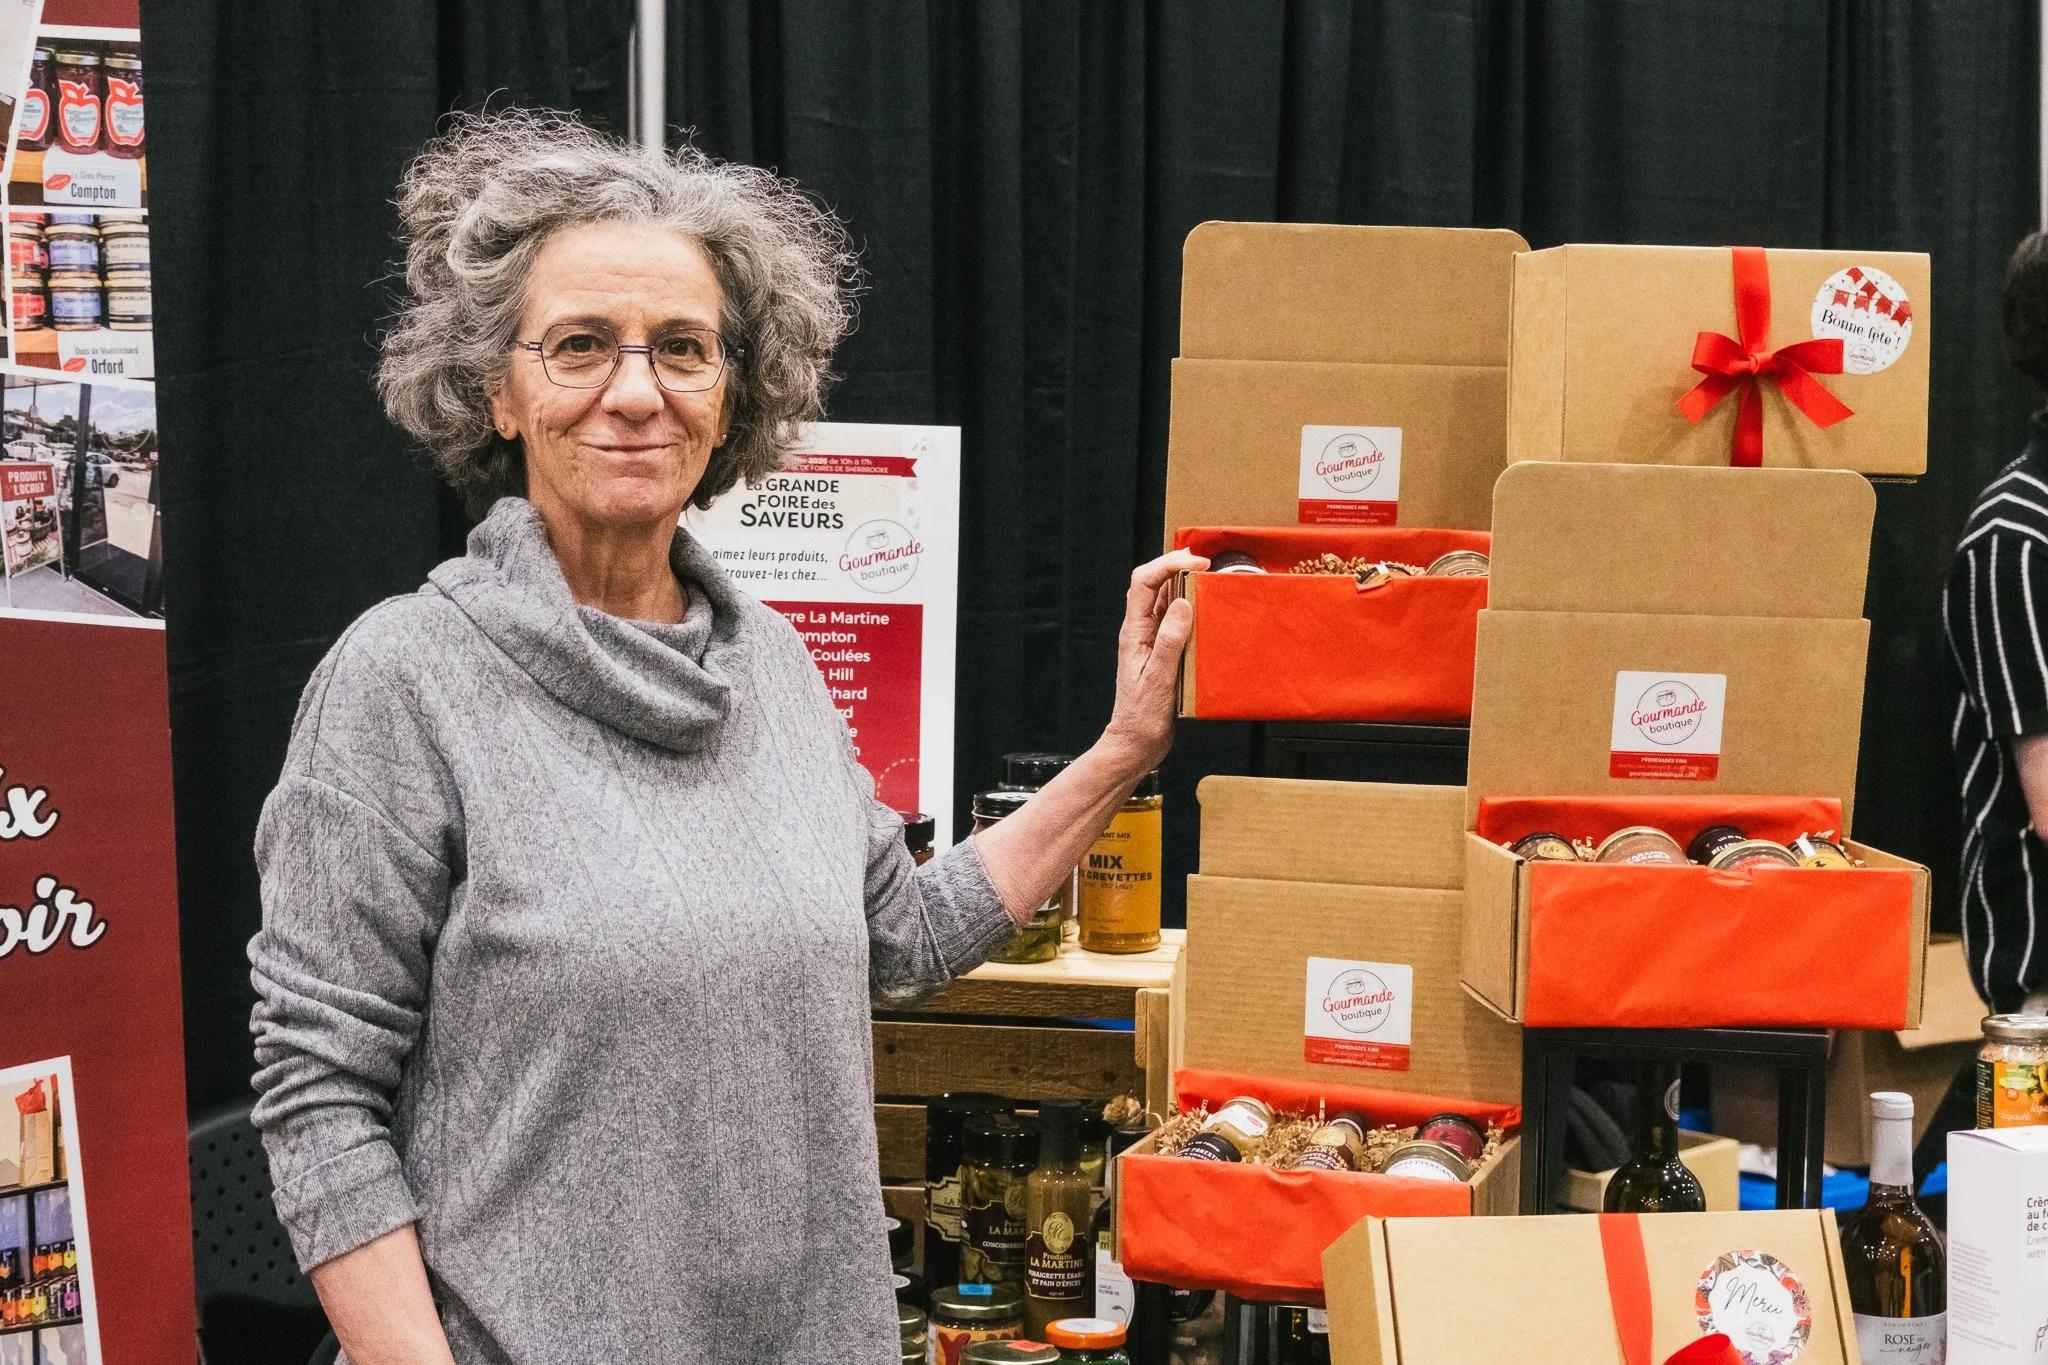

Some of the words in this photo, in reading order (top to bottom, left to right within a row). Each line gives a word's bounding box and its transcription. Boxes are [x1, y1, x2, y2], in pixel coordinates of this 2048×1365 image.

[71, 183, 116, 201] Compton
[1822, 309, 1863, 335] Bonne
[92, 359, 124, 374] Orford
[1316, 450, 1385, 476] Gourmande
[7, 471, 48, 483] PRODUITS
[1333, 468, 1373, 483] boutique
[13, 483, 45, 495] LOCAUX
[766, 479, 839, 493] GRANDE
[758, 495, 809, 509] FOIRE
[811, 499, 836, 510] des
[740, 503, 844, 529] SAVEURS
[712, 549, 745, 560] aimez
[748, 549, 775, 561] leurs
[778, 550, 828, 563] produits,
[839, 540, 924, 571] Gourmande
[725, 568, 788, 580] rouvez-les
[792, 568, 828, 581] chez...
[861, 562, 908, 580] boutique
[783, 612, 805, 623] cre
[810, 611, 826, 624] La
[831, 611, 889, 625] Martine
[799, 631, 857, 645] ompton
[811, 648, 871, 662] Coulées
[829, 668, 854, 680] Hill
[1631, 699, 1706, 727] Gourmande
[1650, 718, 1693, 734] boutique
[1089, 854, 1123, 869] MIX
[1322, 989, 1395, 1013] Gourmande
[1341, 1008, 1382, 1021] boutique
[2027, 1212, 2039, 1220] au
[989, 1225, 1000, 1235] LA
[1003, 1227, 1025, 1235] MAR
[2027, 1222, 2039, 1231] de
[1030, 1257, 1039, 1267] LA
[1042, 1259, 1084, 1269] MARTINE
[1043, 1252, 1072, 1260] Produits
[1040, 1279, 1054, 1287] PAIN
[1724, 1277, 1782, 1314] Merci
[1884, 1334, 1915, 1344] ROSE
